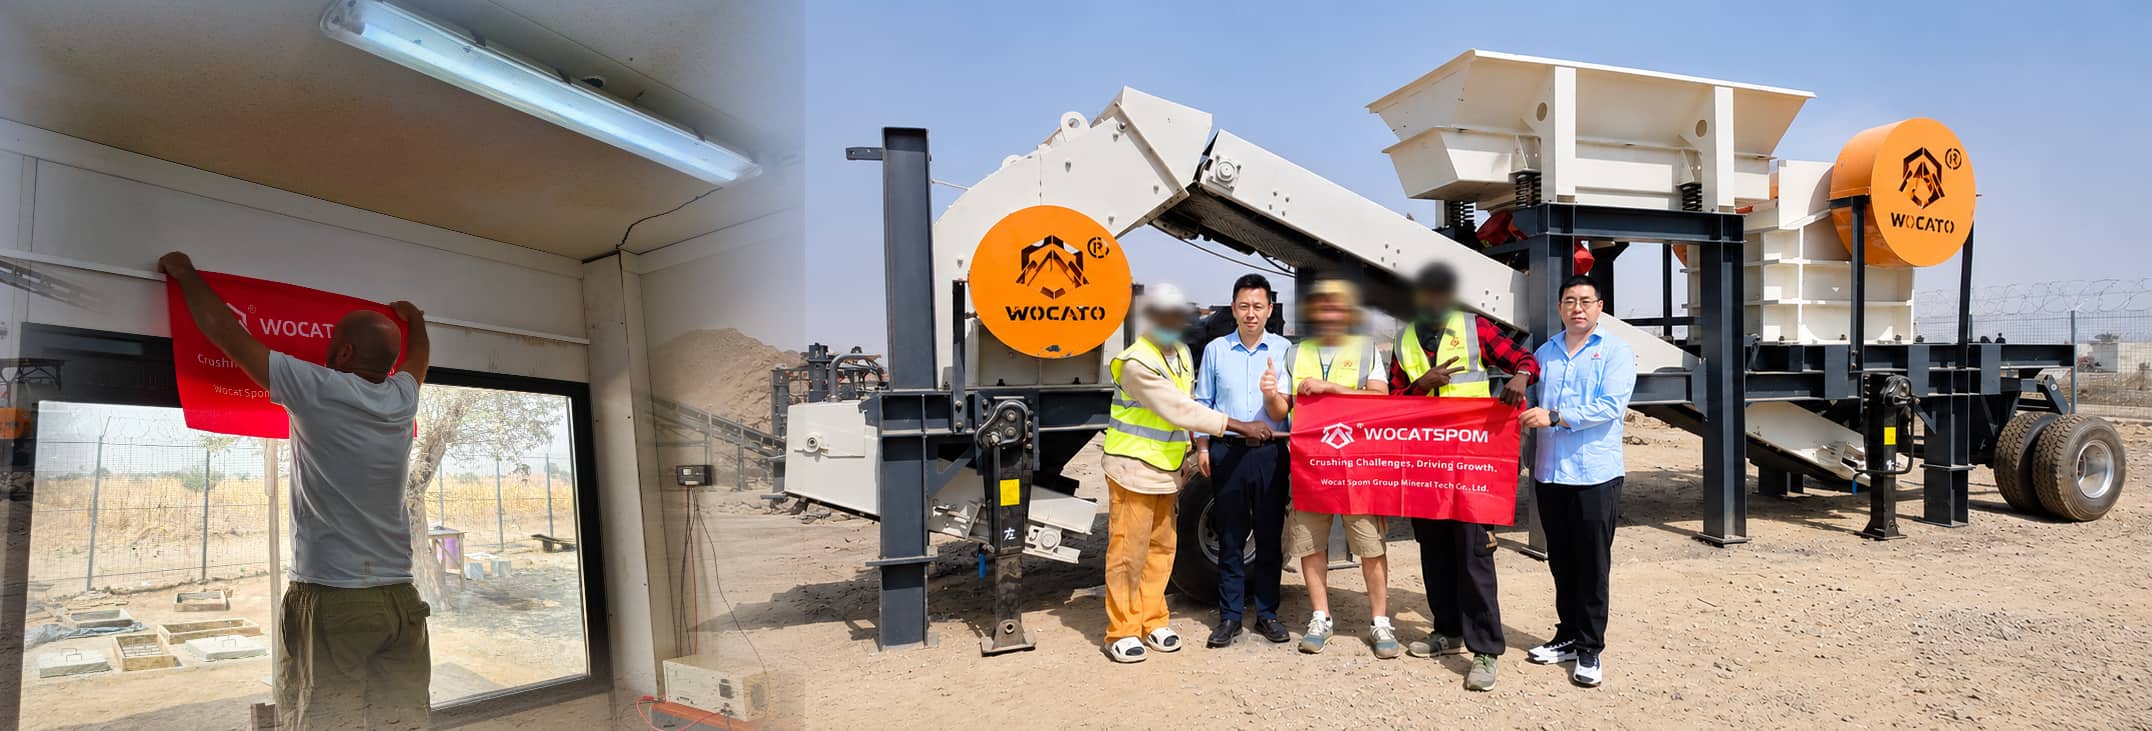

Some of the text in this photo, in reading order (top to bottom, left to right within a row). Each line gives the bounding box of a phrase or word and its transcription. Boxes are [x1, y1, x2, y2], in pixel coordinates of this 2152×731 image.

[1890, 212, 1955, 234] WOCATO
[1005, 306, 1106, 321] WOCATO
[259, 317, 335, 339] WOCAT
[213, 384, 243, 397] Wocat
[1363, 427, 1489, 443] WOCATSPOM
[1309, 458, 1498, 473] Crushing Challenges, Driving Growth.
[1321, 477, 1346, 487] Wocat
[1347, 479, 1371, 488] Spom
[1372, 479, 1399, 488] Group
[1401, 479, 1433, 489] Mineral
[1433, 481, 1454, 490] Tech
[1003, 527, 1017, 541] 左
